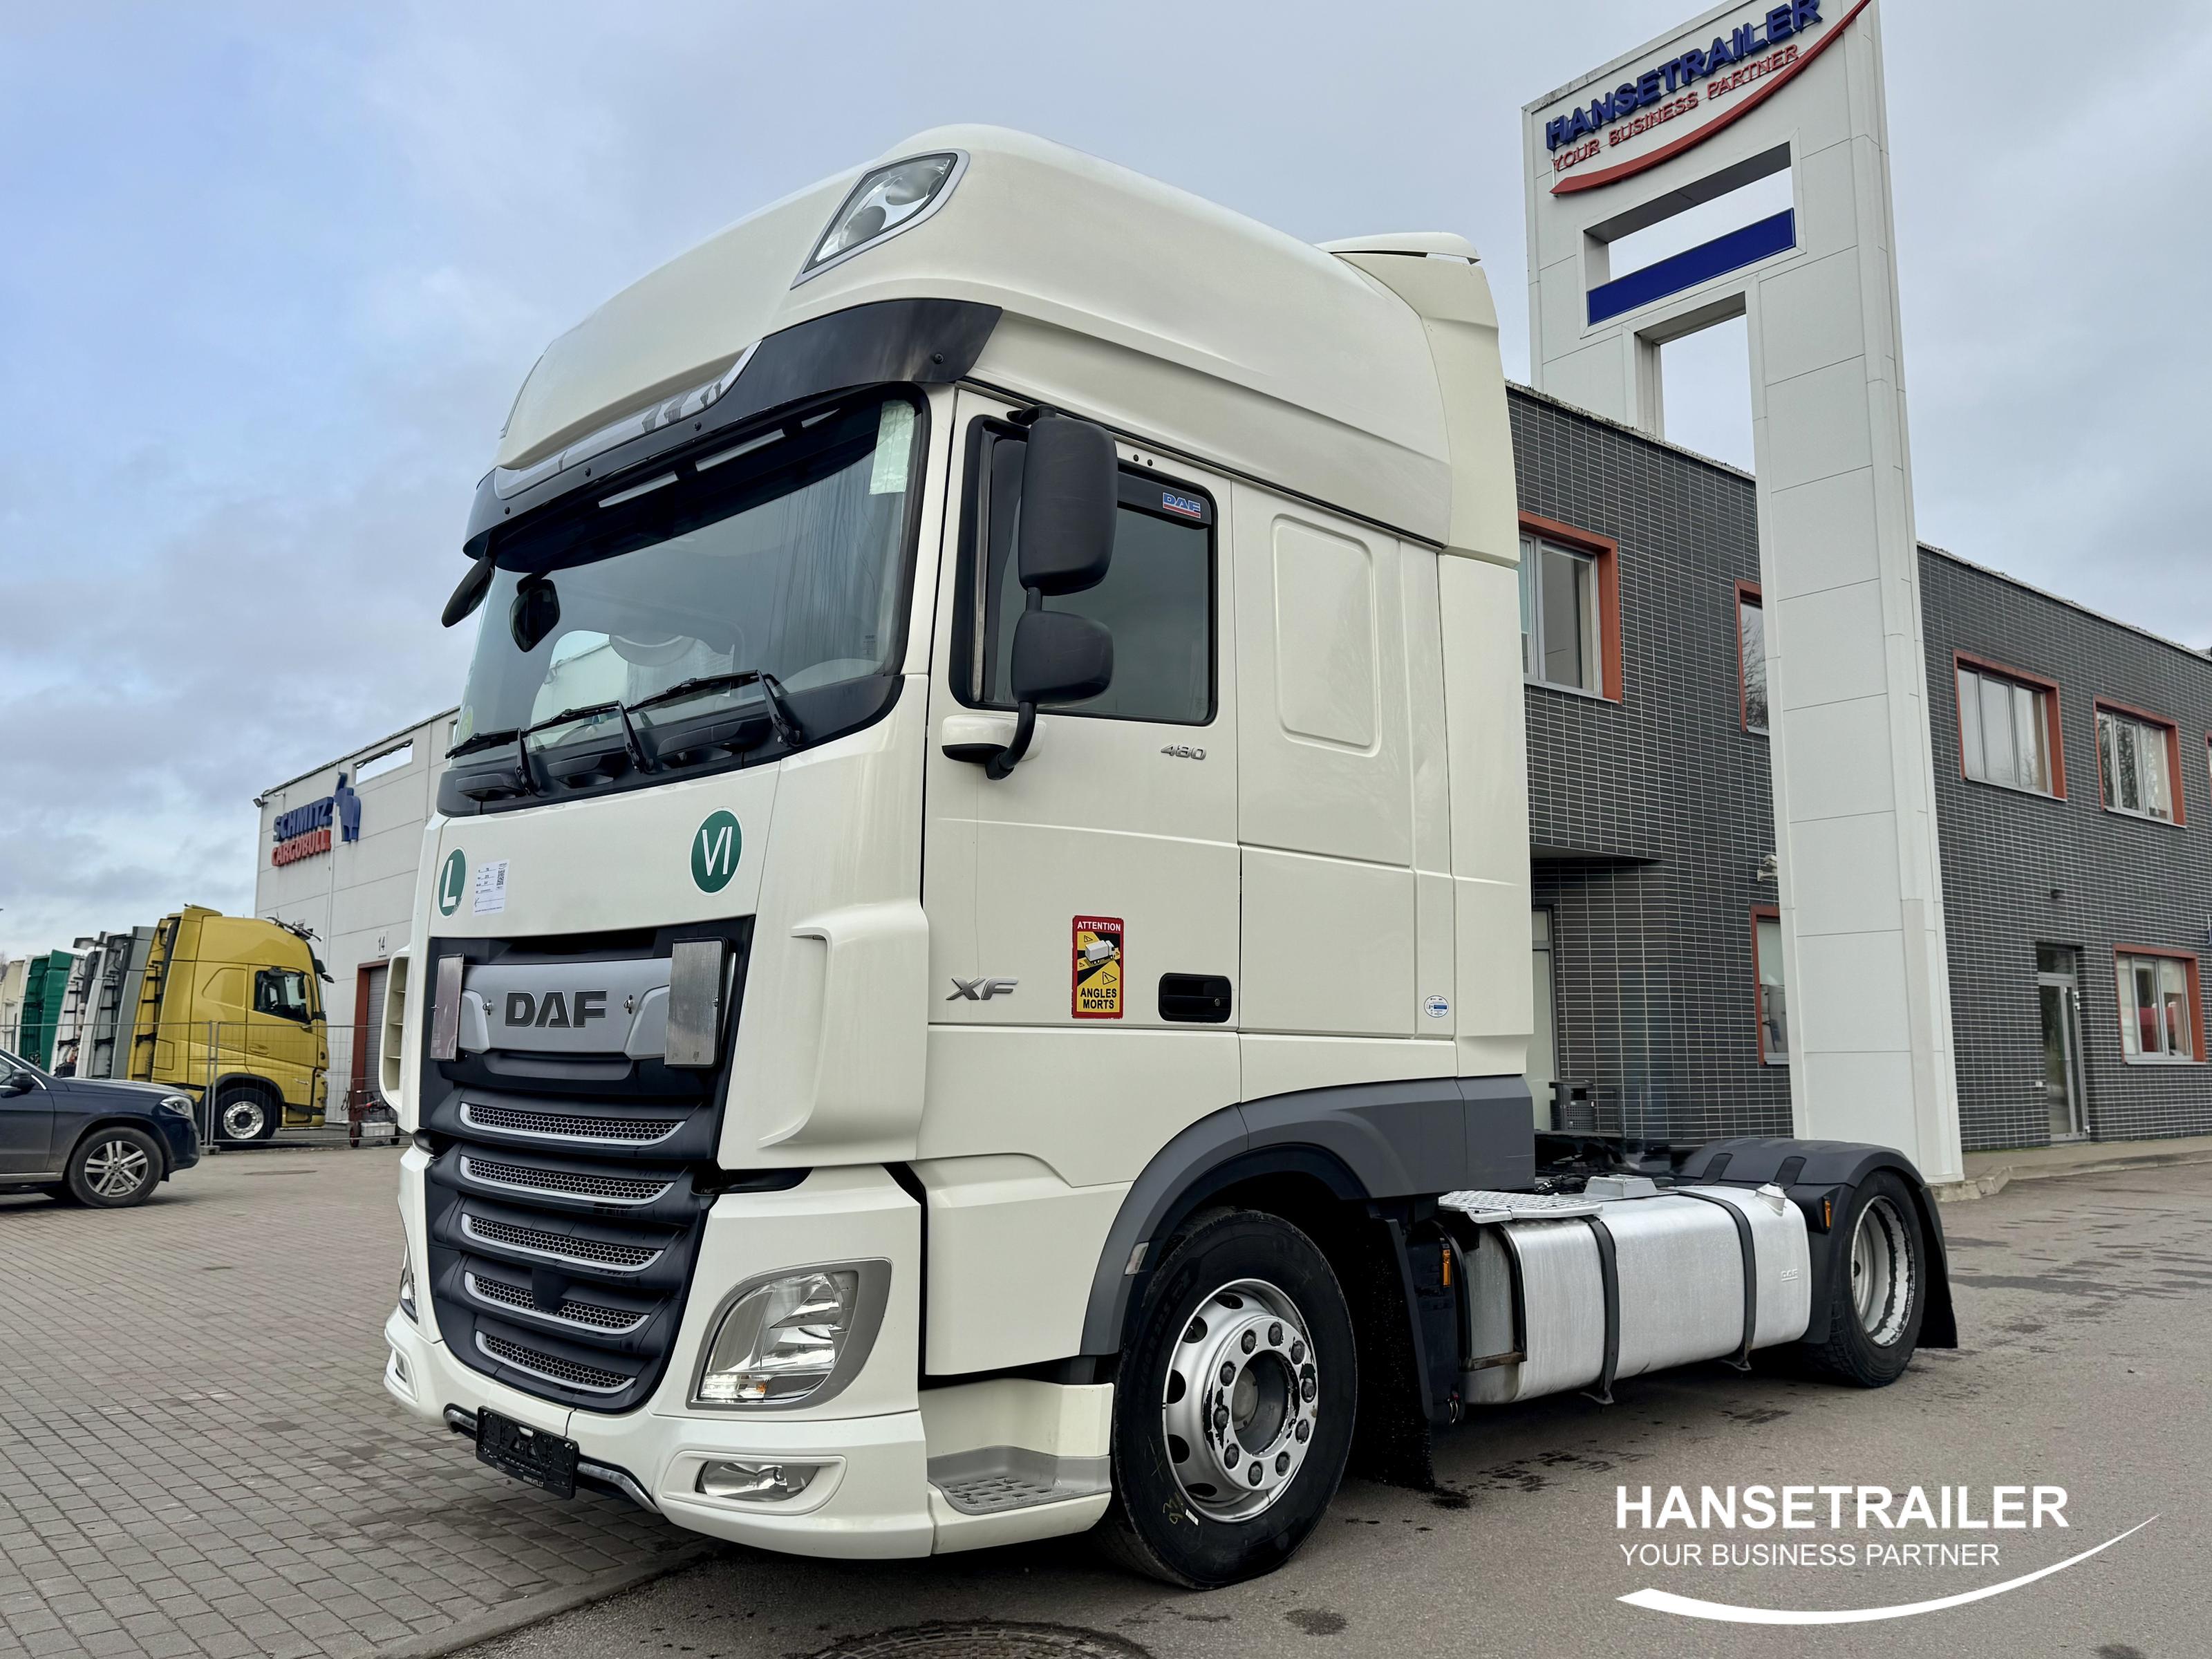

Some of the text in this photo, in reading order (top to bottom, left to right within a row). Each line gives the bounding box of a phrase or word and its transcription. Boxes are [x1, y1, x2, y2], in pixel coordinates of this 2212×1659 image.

[1546, 0, 1823, 151] HANSETRAILER
[1553, 44, 1799, 171] YOUR BUSINESS PARTNER
[1163, 492, 1201, 514] DAF
[273, 796, 335, 842] SCHMITZ
[272, 830, 331, 867] CARGOBULL
[702, 826, 733, 877] VI
[442, 859, 457, 908] L
[377, 935, 386, 952] 14
[1077, 921, 1121, 932] ATTENTION
[946, 977, 1019, 1000] XF
[1080, 988, 1117, 998] ANGLES
[1083, 999, 1114, 1009] MORTS
[505, 989, 608, 1028] DAF
